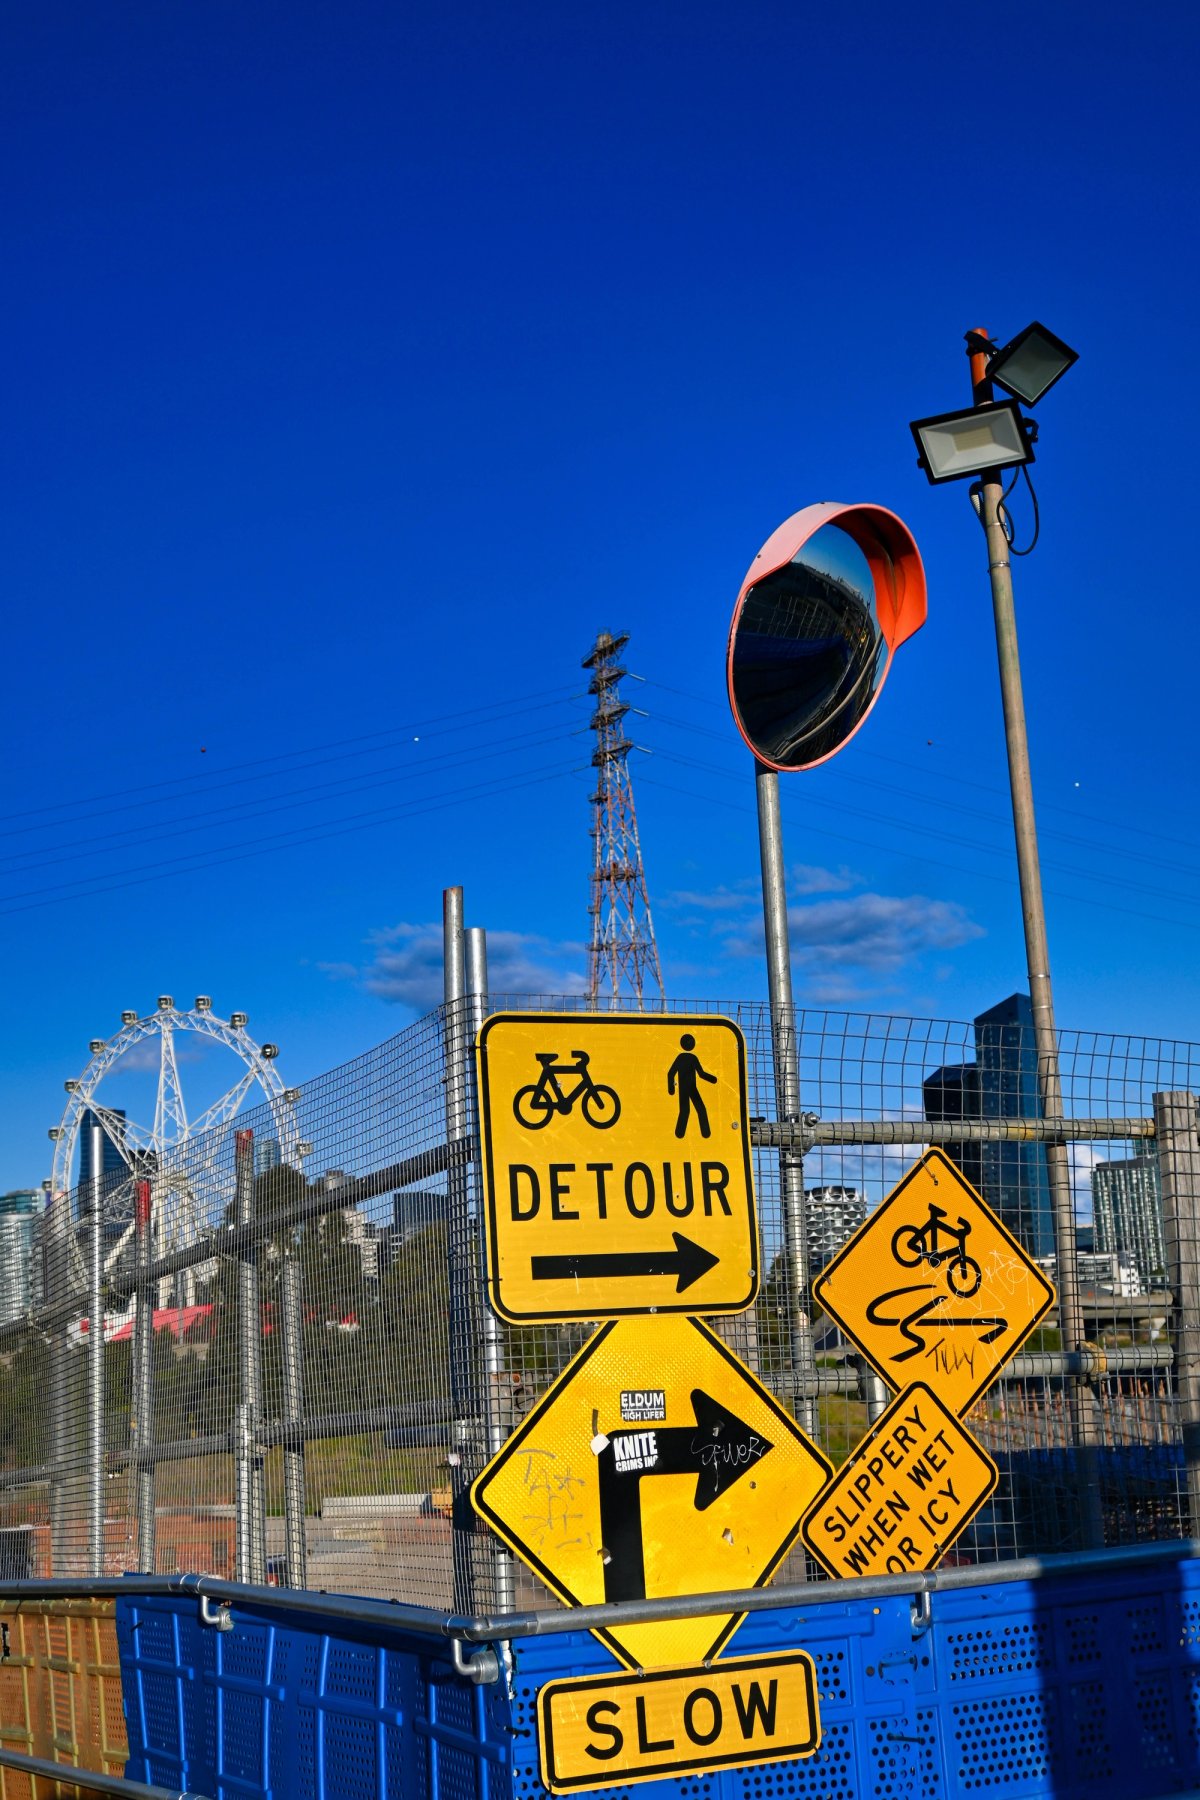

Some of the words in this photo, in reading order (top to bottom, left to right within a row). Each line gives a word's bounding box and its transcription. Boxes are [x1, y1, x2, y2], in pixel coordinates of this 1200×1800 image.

[508, 1161, 733, 1221] DETOUR
[621, 1392, 664, 1408] ELDUM
[622, 1411, 641, 1420] HIGH
[643, 1410, 665, 1420] LIFER
[613, 1431, 659, 1462] KNITE
[615, 1457, 643, 1472] CRIMS
[824, 1404, 927, 1543] SLIPPERY
[843, 1490, 910, 1576] WHEN
[906, 1429, 955, 1491] WET
[886, 1536, 923, 1574] OR
[918, 1477, 961, 1537] ICY
[584, 1678, 778, 1760] SLOW
